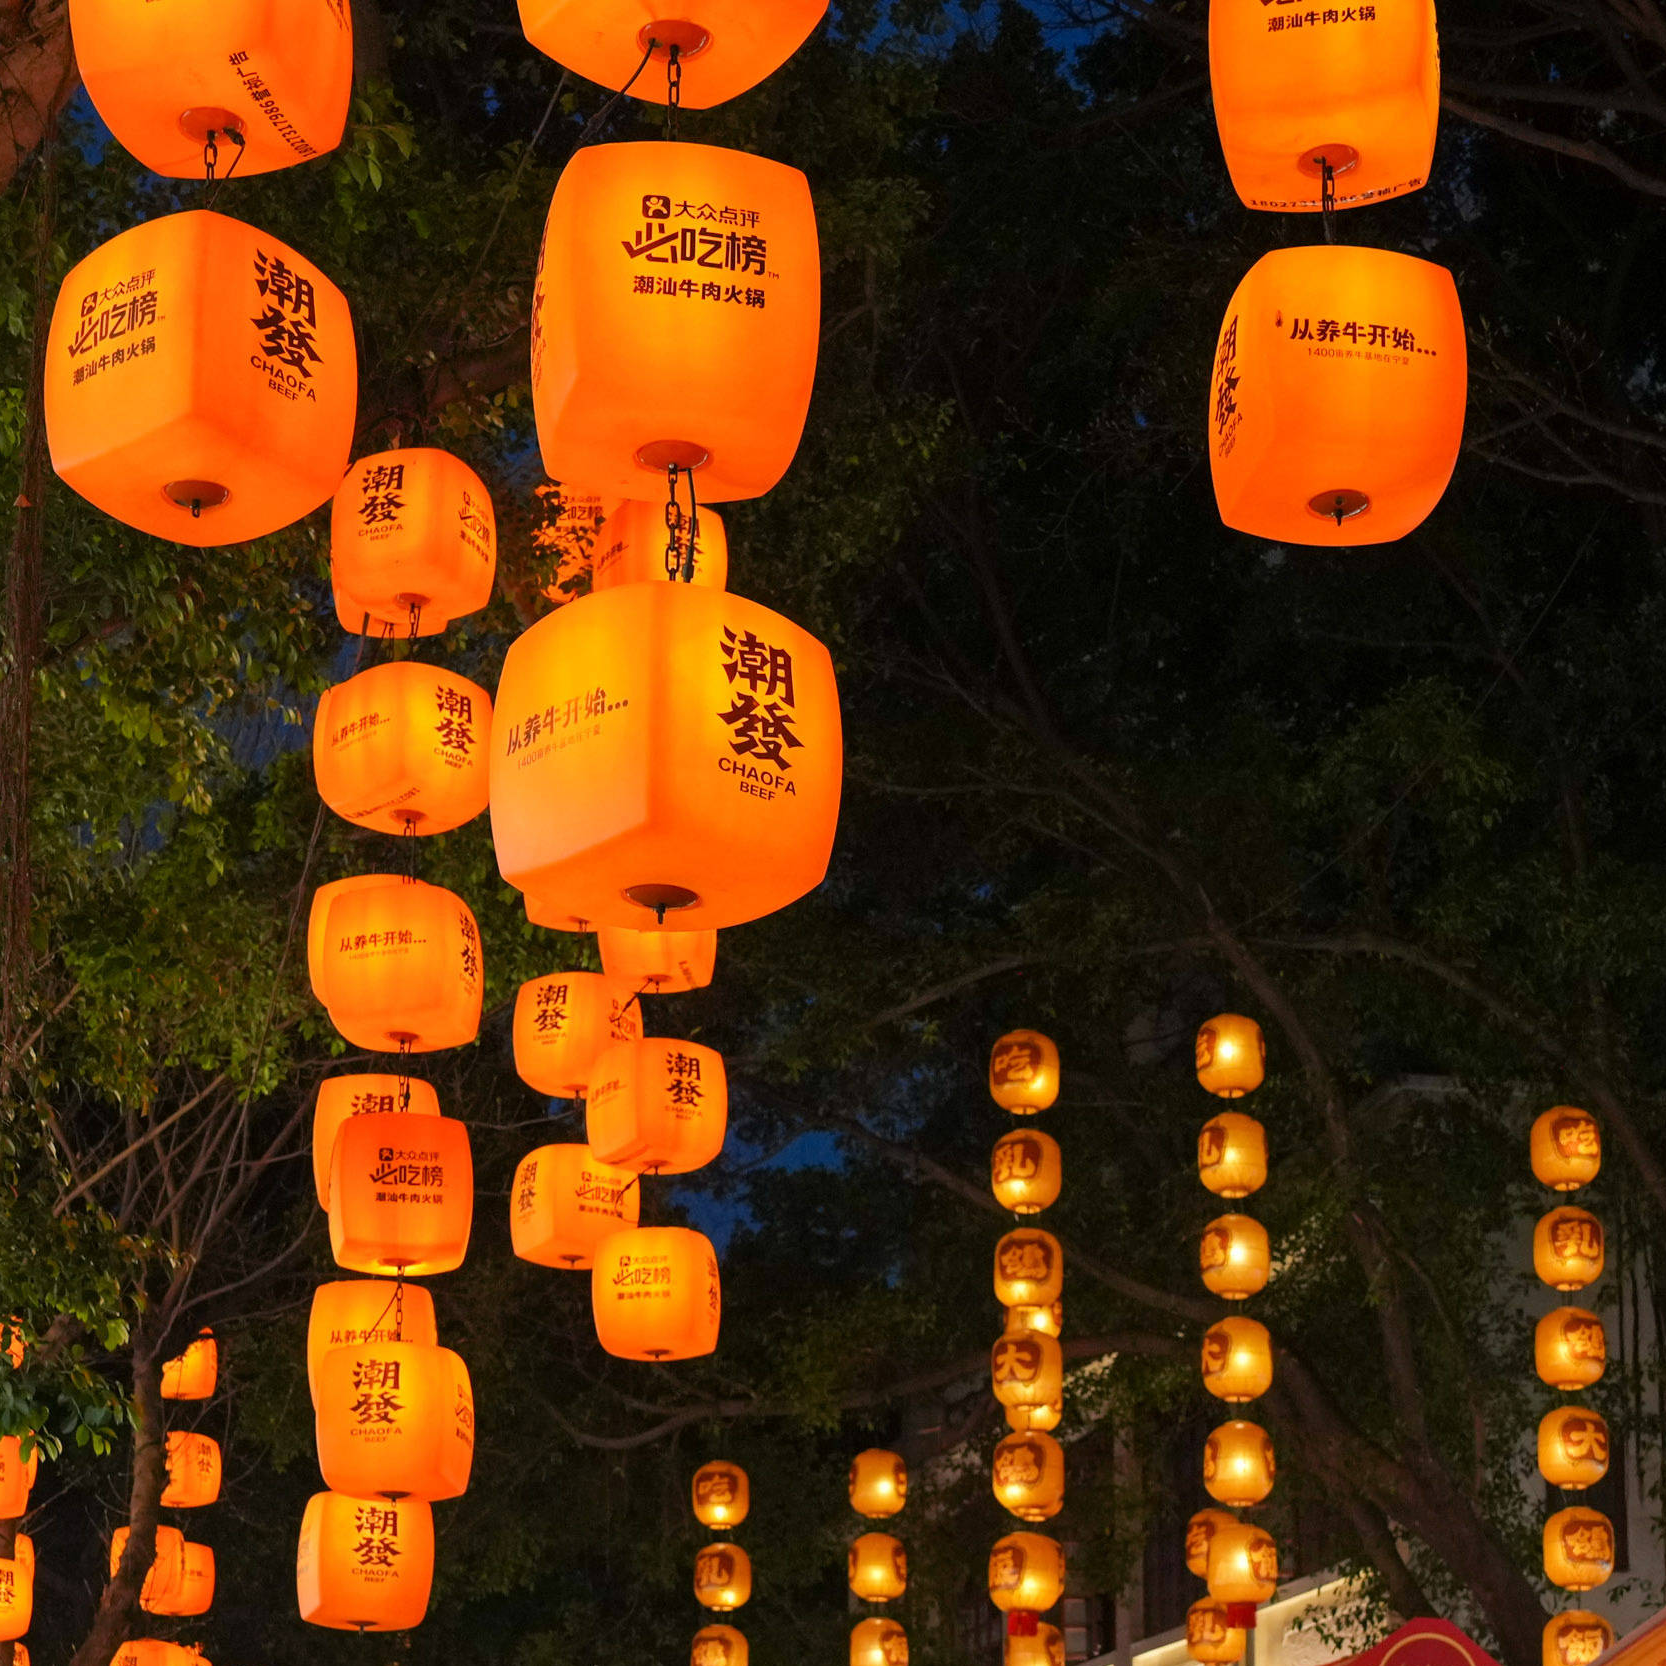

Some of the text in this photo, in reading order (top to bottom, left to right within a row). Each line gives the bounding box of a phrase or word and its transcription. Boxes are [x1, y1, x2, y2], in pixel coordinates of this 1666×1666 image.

[1268, 6, 1376, 33] 潮汕牛肉火锅
[674, 199, 760, 228] 大众点评
[621, 223, 767, 274] 必吃榜
[99, 268, 156, 306] 大众点评
[633, 275, 765, 309] 潮汕牛肉火锅
[68, 294, 159, 358] 必吃榜
[251, 249, 324, 378] 潮發
[72, 335, 156, 386] 潮汕牛肉火锅
[251, 355, 316, 402] CHAOFA
[267, 379, 300, 401] BEEF
[358, 464, 405, 524] 潮發
[358, 524, 403, 538] CHAOFA
[718, 625, 804, 771] 潮發
[435, 684, 476, 754] 潮發
[434, 748, 473, 766] CHAOFA
[719, 757, 796, 796] CHAOFA
[739, 781, 776, 801] BEEF
[533, 984, 570, 1032] 潮發
[665, 1051, 705, 1108] 潮發
[369, 1163, 443, 1187] 必吃榜
[395, 1150, 439, 1162] 大众点评
[612, 1266, 671, 1287] 必吃榜
[995, 1344, 1033, 1381] 大
[350, 1359, 406, 1425] 潮發
[350, 1427, 403, 1436] CHAOFA
[1568, 1422, 1605, 1458] 大
[352, 1507, 402, 1567] 潮發
